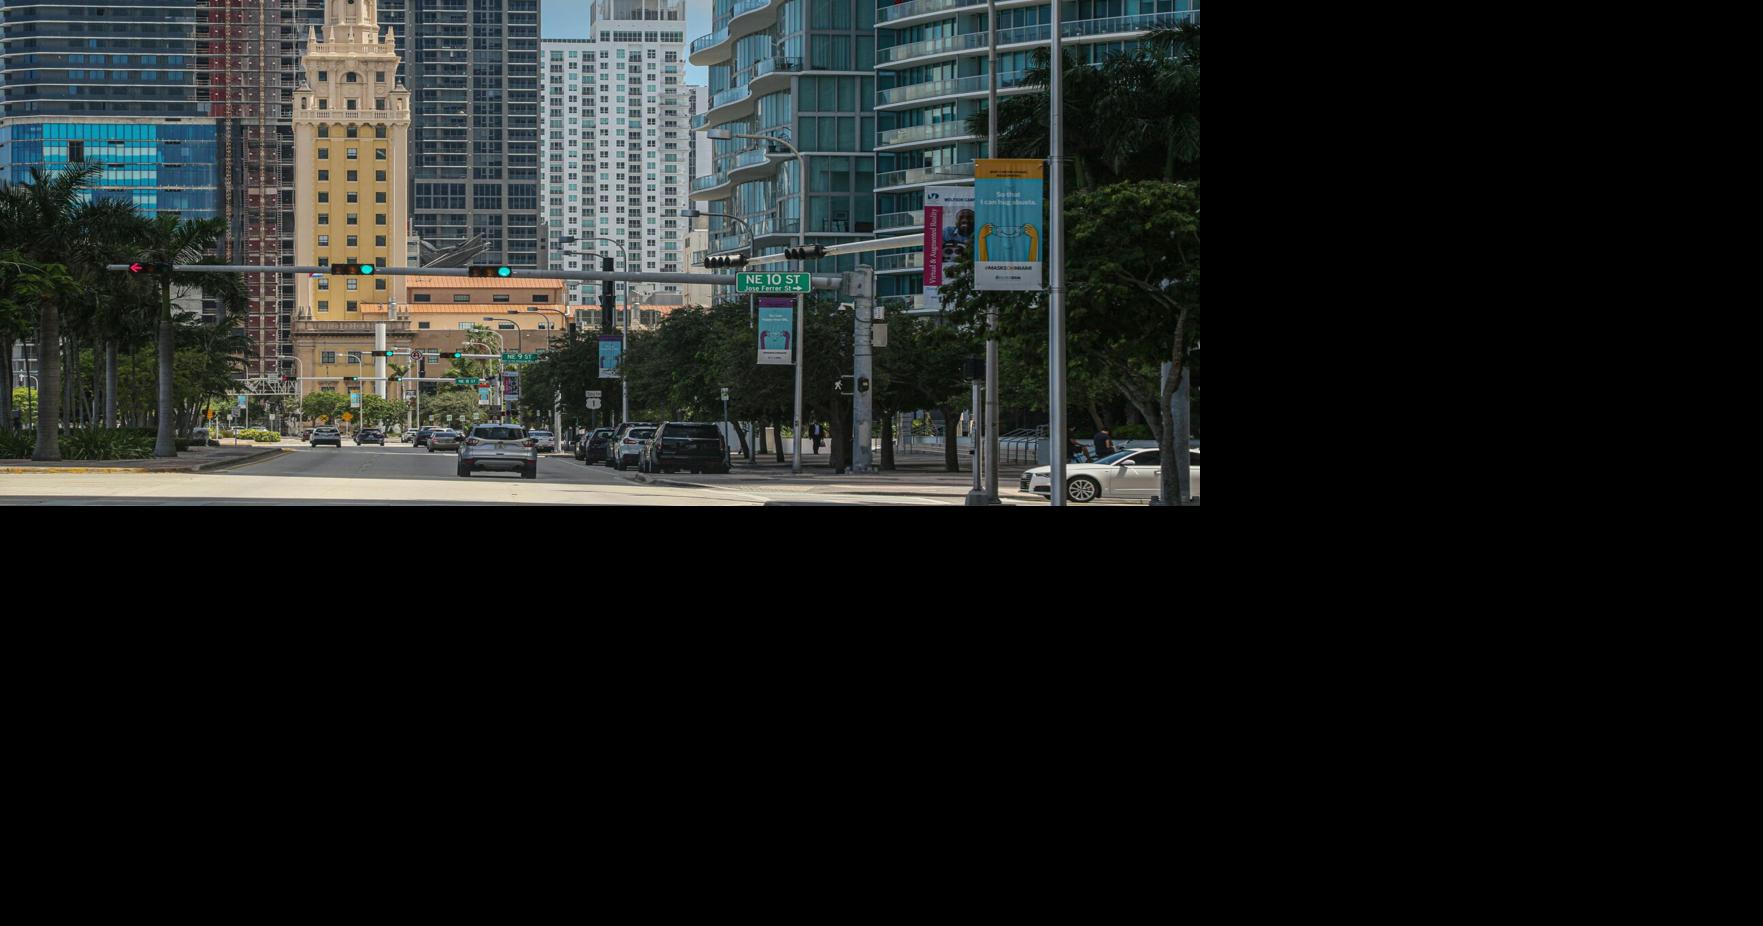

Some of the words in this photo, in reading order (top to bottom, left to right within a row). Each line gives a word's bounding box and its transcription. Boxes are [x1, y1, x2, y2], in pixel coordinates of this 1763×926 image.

[929, 208, 939, 227] Reality
[929, 227, 938, 257] Augmented
[746, 274, 763, 284] NE
[766, 273, 782, 285] 10
[785, 274, 801, 284] ST
[929, 264, 937, 284] Virtual
